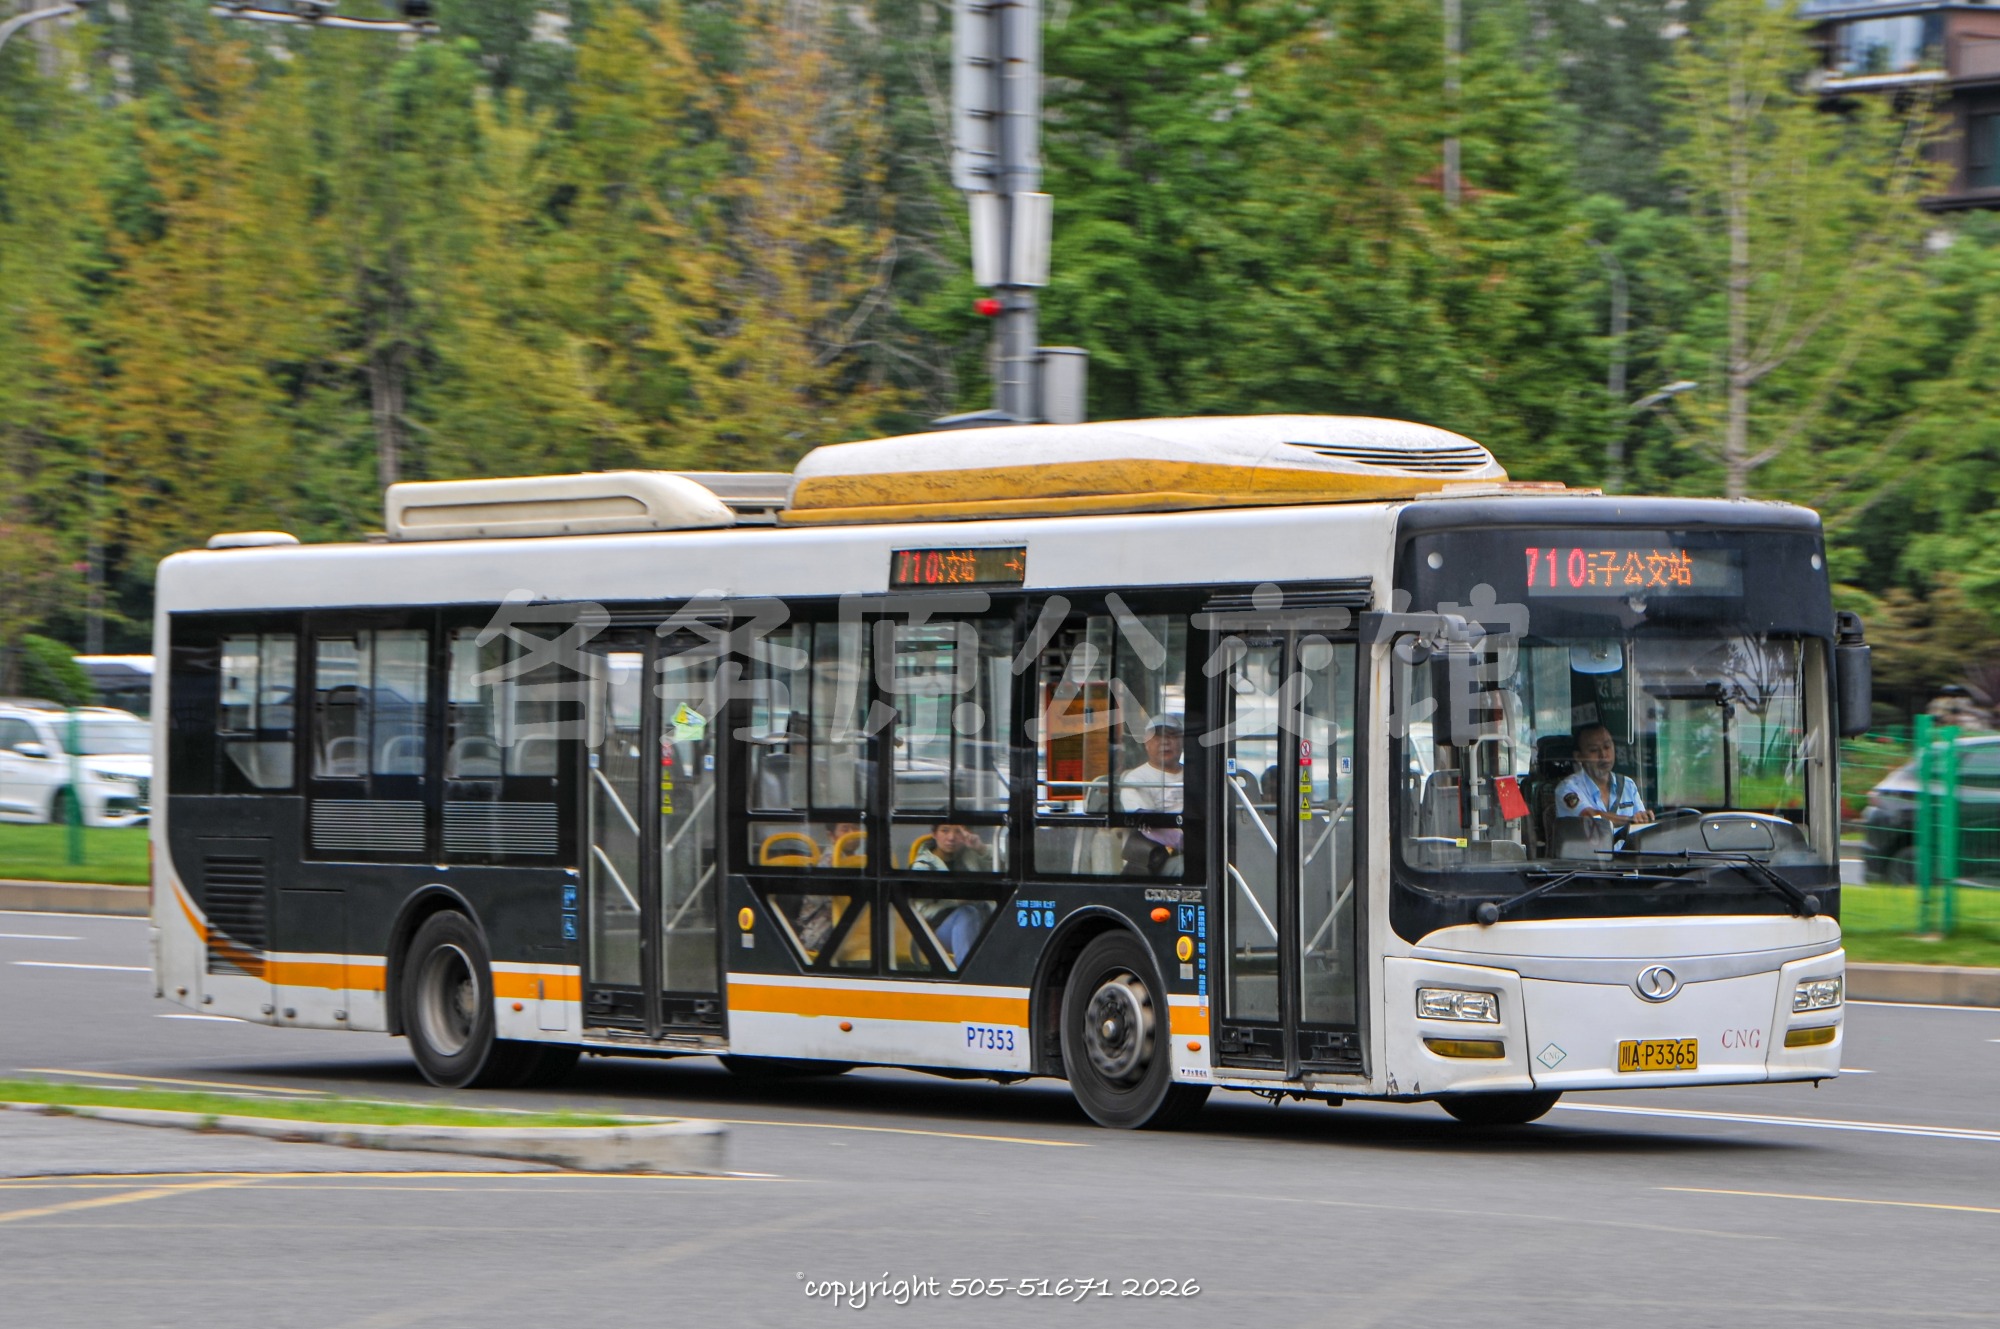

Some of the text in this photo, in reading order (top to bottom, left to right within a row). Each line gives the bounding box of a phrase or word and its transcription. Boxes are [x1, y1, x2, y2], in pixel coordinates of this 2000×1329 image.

[900, 551, 939, 583] 710
[1526, 548, 1586, 587] 710
[967, 1026, 1014, 1051] P7353
[1721, 1029, 1760, 1049] CNG
[1543, 1051, 1560, 1061] CNG
[1621, 1042, 1696, 1067] 川A·P3365
